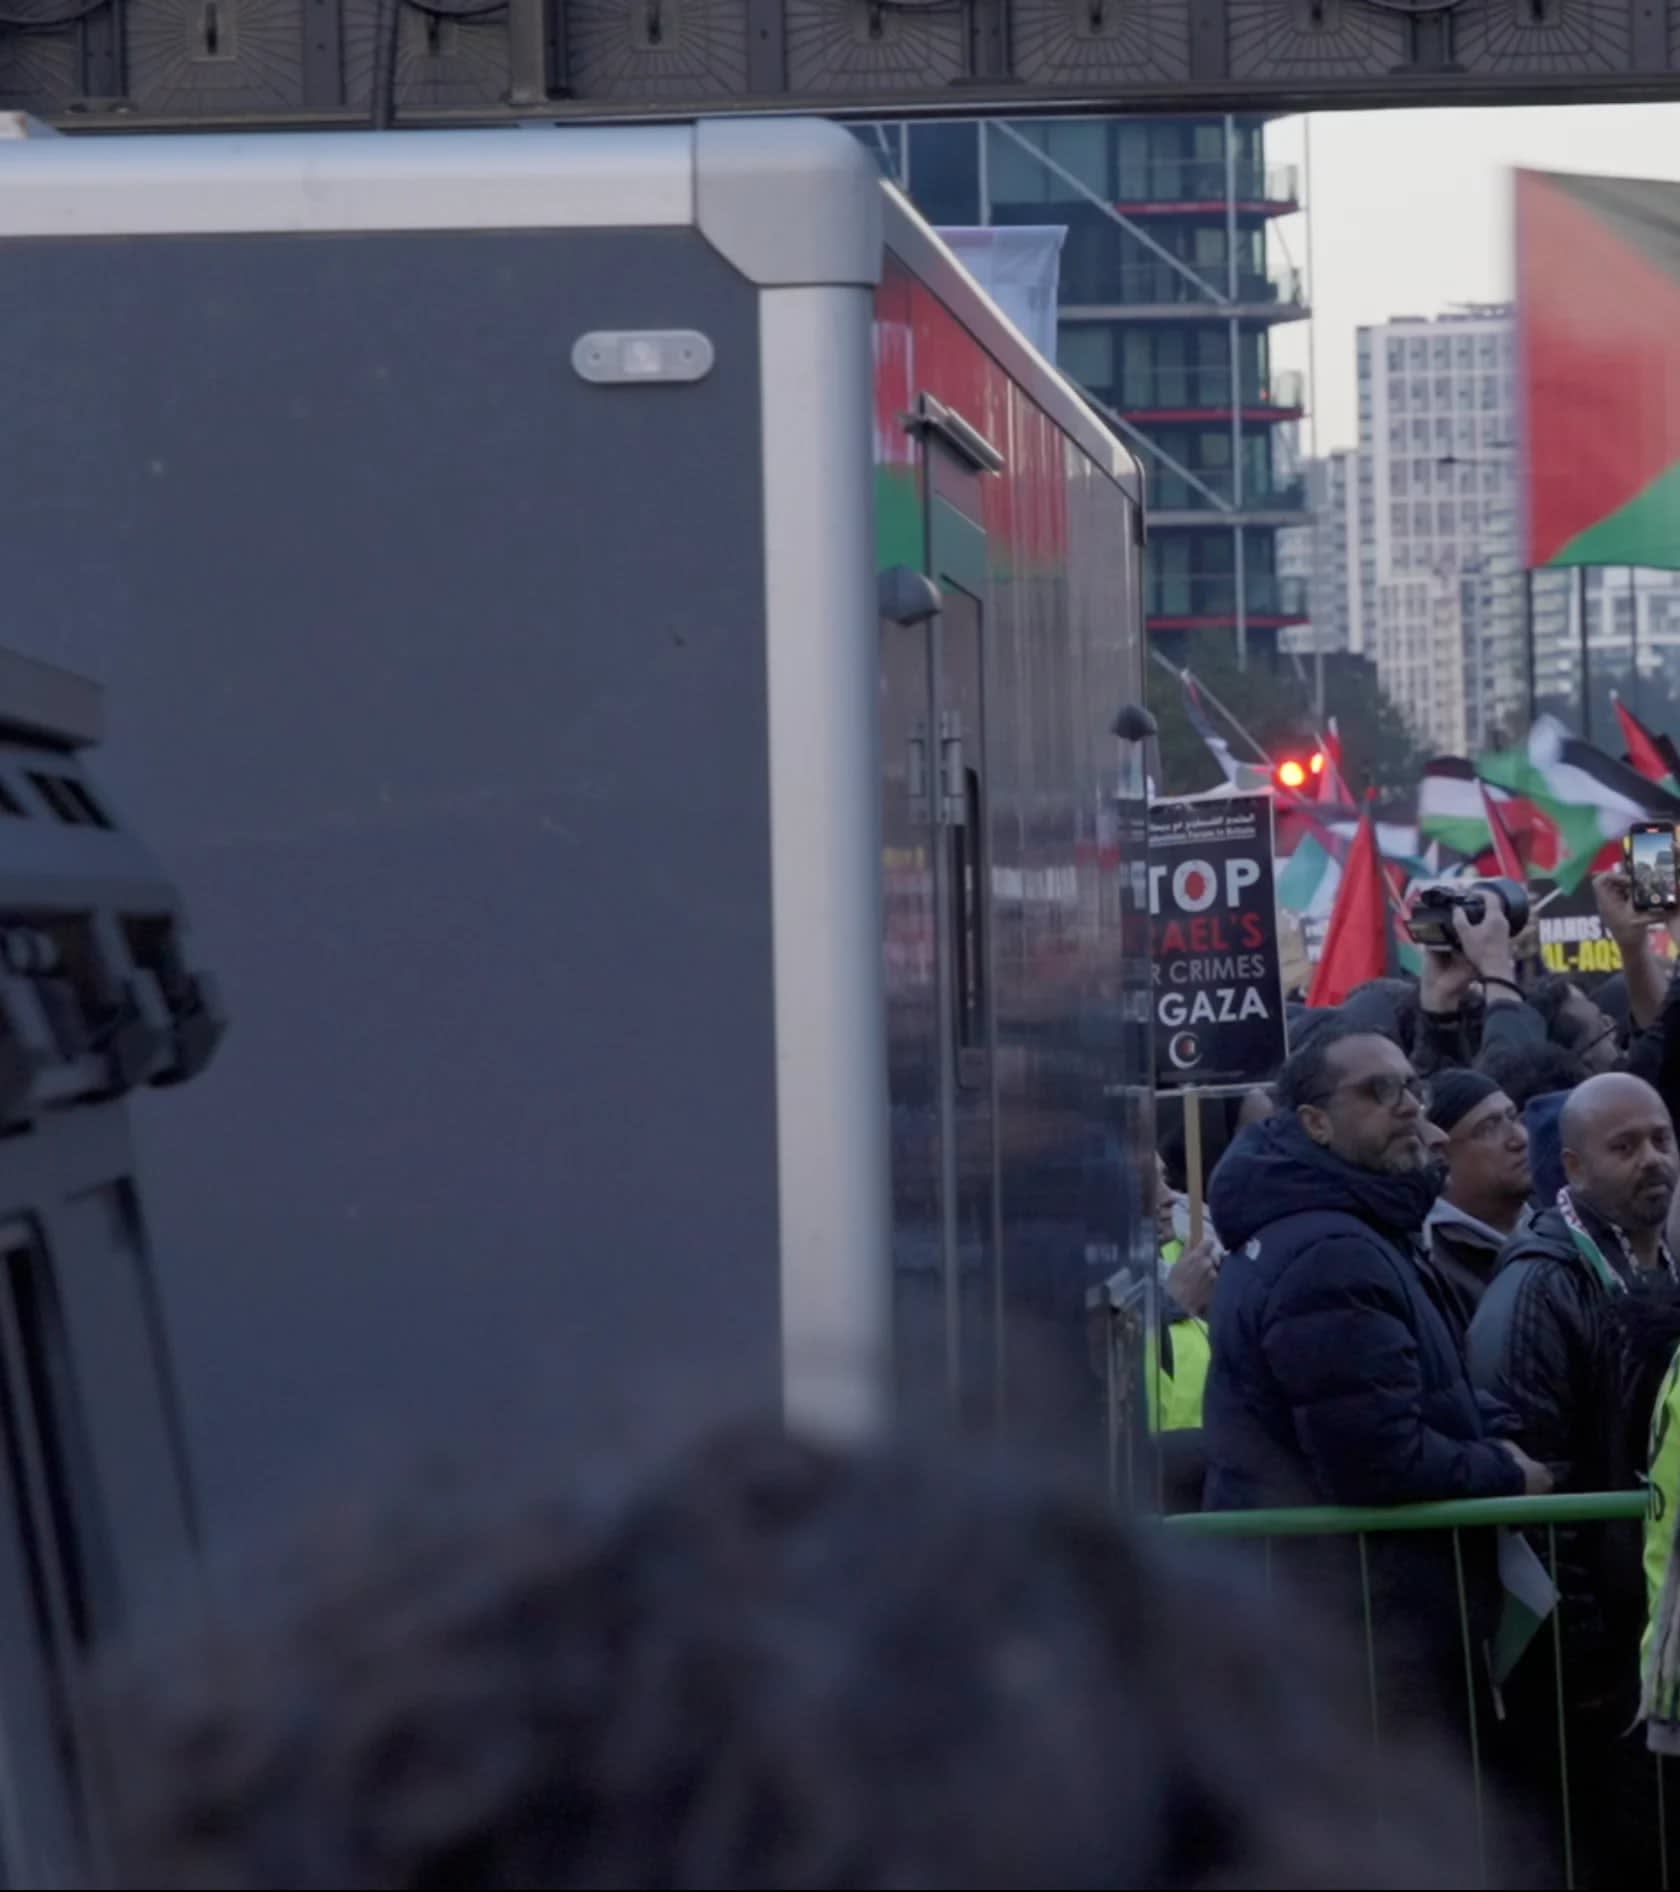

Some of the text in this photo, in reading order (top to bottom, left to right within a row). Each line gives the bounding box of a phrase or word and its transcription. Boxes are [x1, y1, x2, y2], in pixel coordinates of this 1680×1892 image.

[1149, 858, 1261, 915] TOP
[1539, 915, 1602, 945] HANDS
[1169, 953, 1266, 985] CRIMES
[1541, 938, 1624, 973] AL-AQS
[1157, 985, 1270, 1027] GAZA
